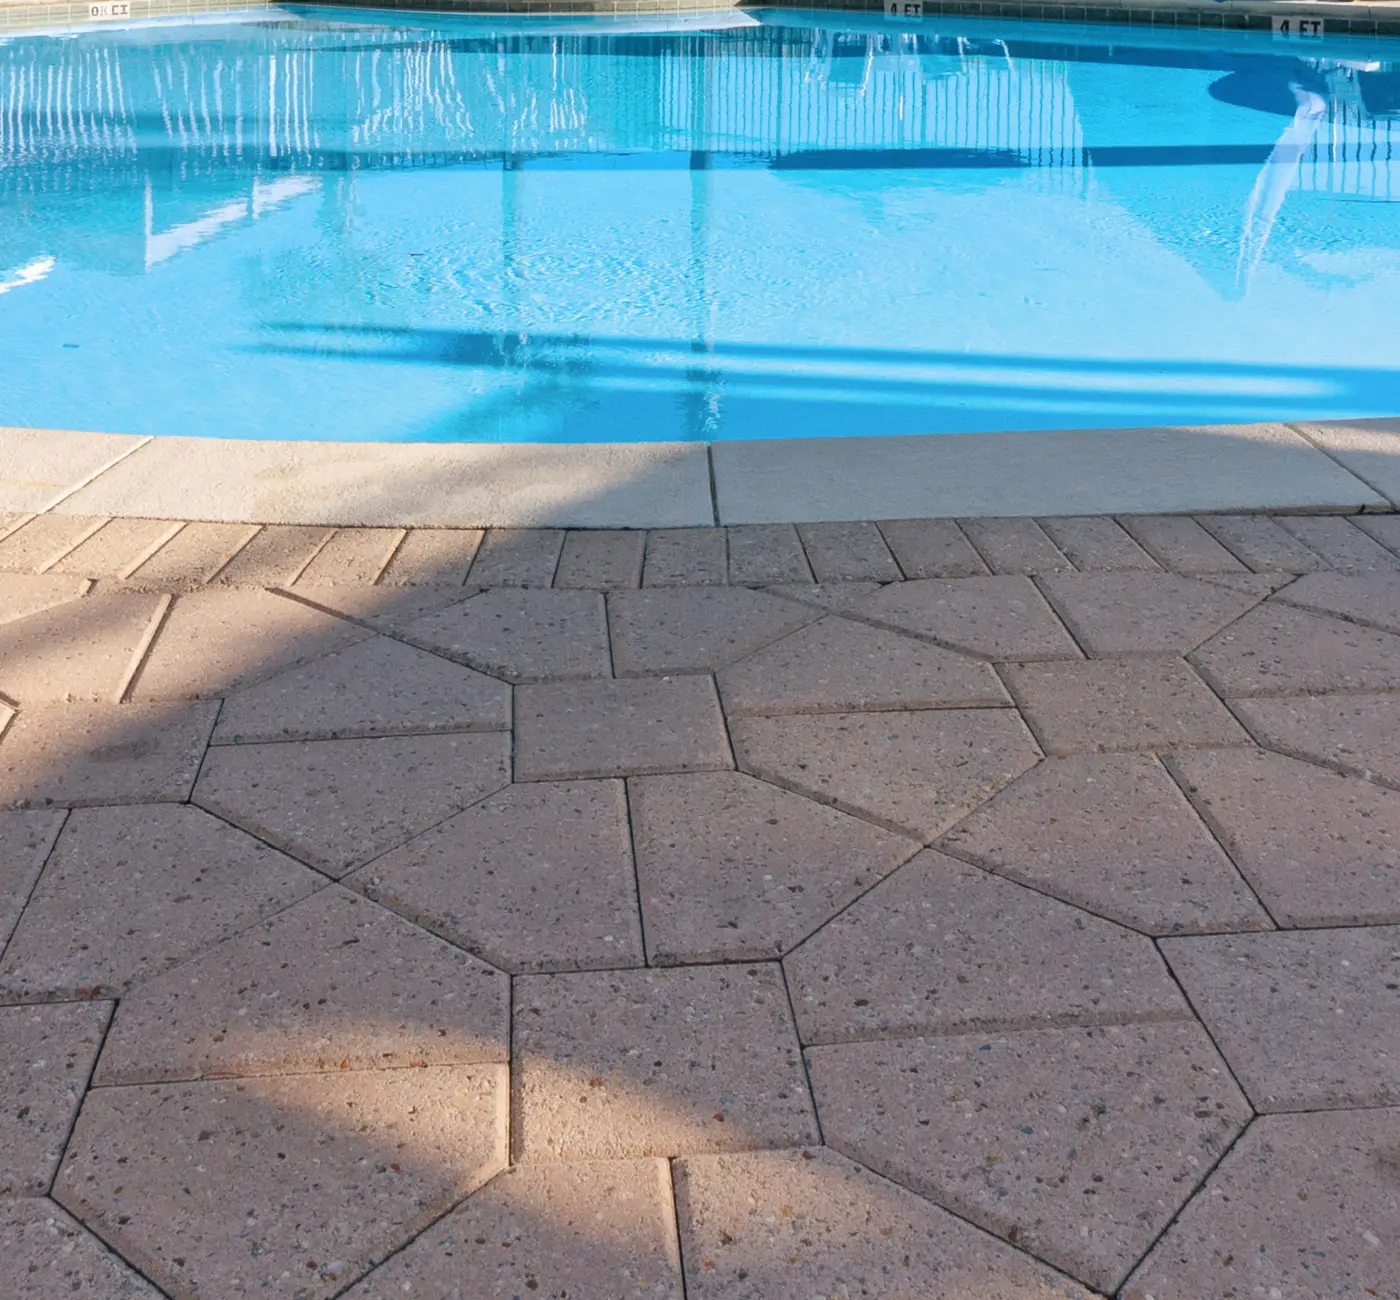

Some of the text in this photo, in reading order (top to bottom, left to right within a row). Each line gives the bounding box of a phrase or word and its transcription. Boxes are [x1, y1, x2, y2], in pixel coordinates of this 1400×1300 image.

[890, 2, 921, 16] 4 FT
[1280, 19, 1321, 35] 4 FT
